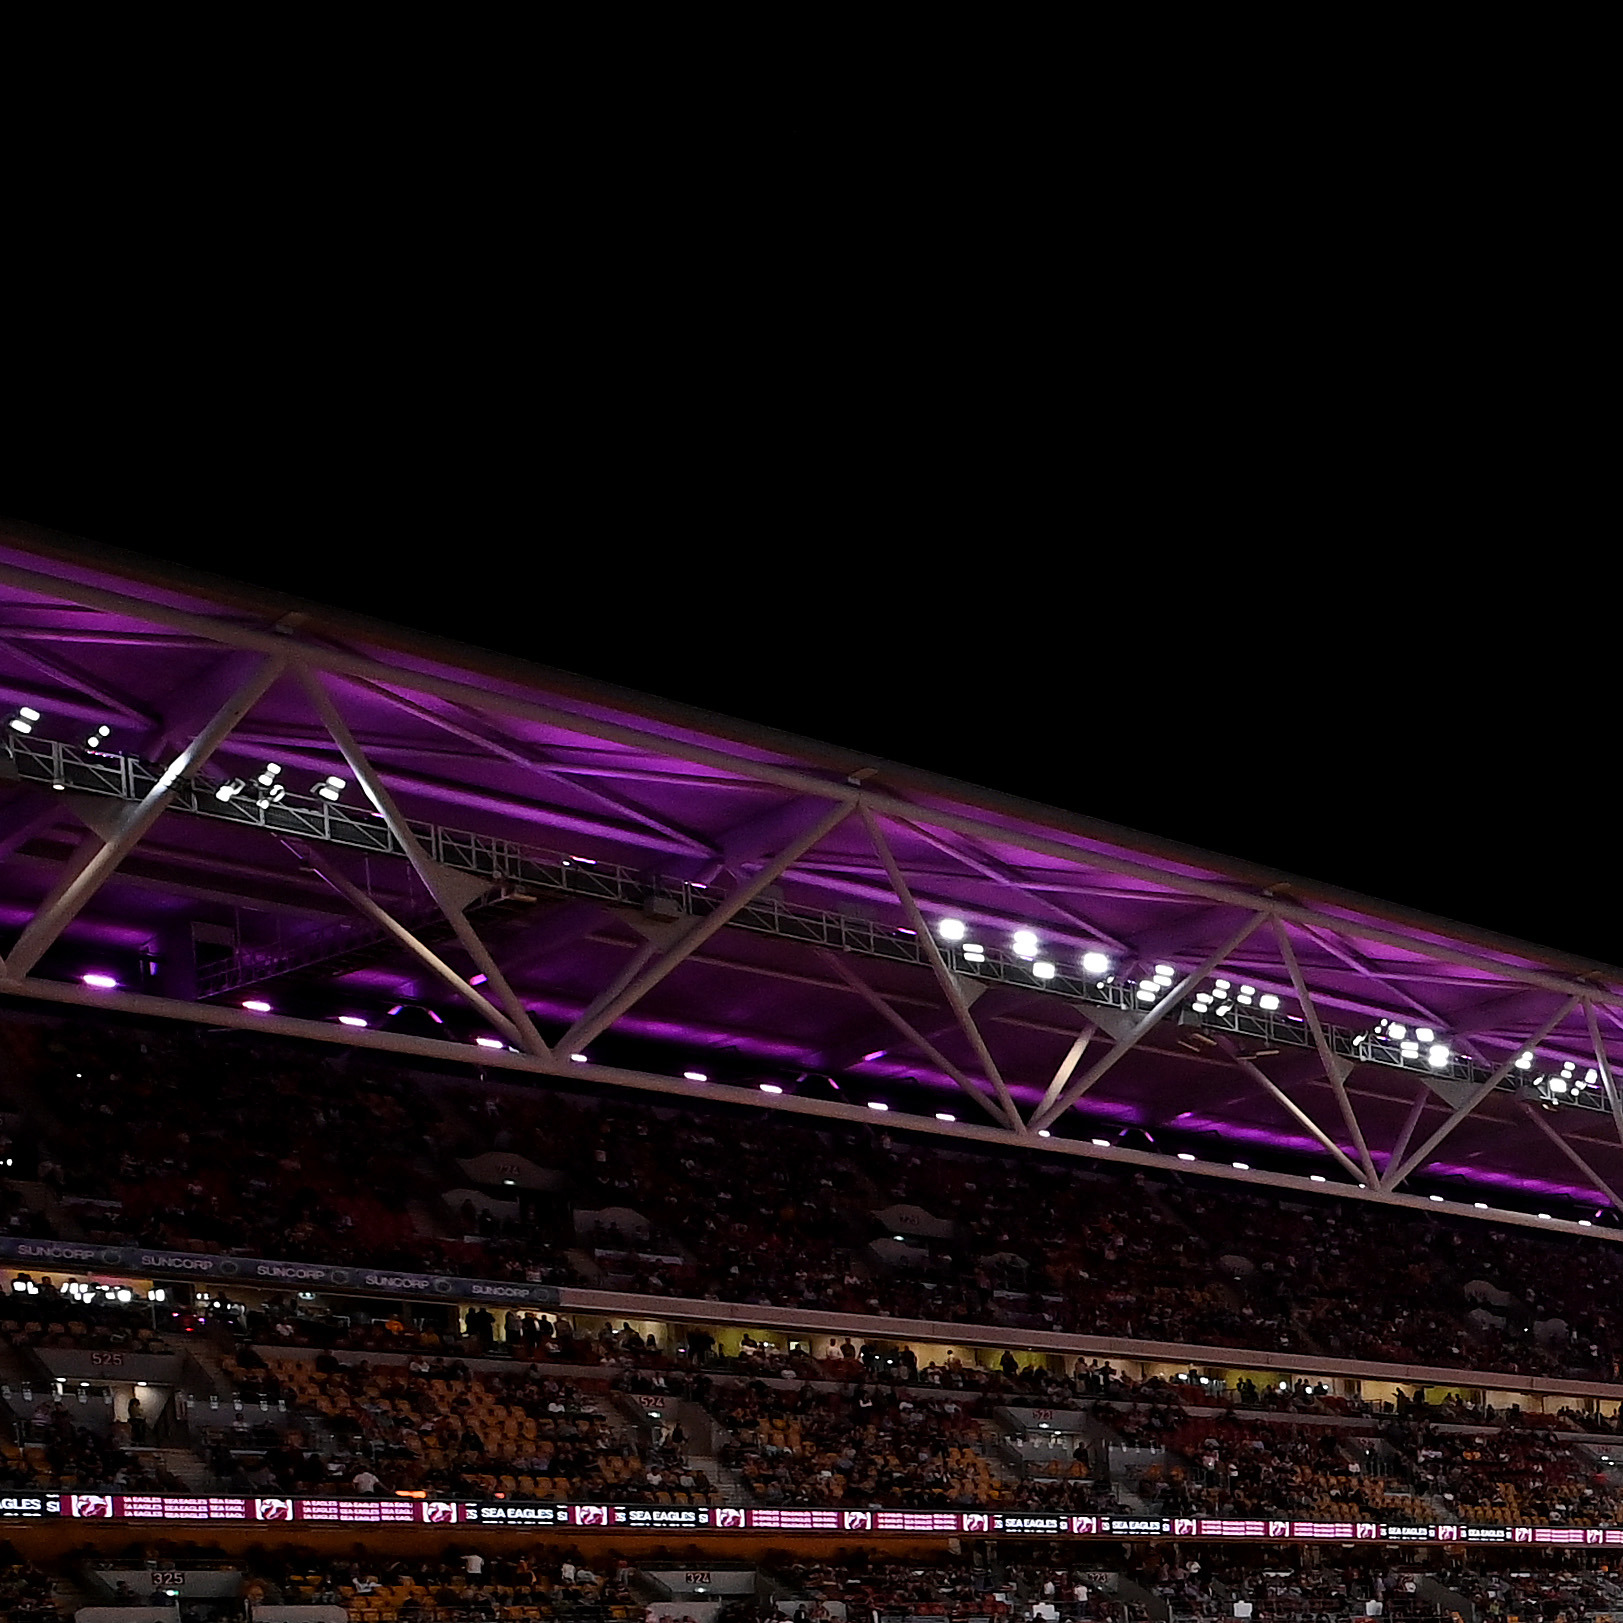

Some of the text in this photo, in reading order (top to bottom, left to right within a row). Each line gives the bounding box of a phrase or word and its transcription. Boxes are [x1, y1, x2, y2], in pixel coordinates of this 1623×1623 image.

[18, 1244, 95, 1261] SUNCORP
[142, 1255, 214, 1271] SUNCORP
[256, 1264, 325, 1280] SUNCORP
[365, 1274, 430, 1290] SUNCORP
[472, 1284, 530, 1298] SUNCORP
[91, 1352, 123, 1365] 525
[641, 1396, 664, 1408] 524
[0, 1499, 41, 1511] GLES
[481, 1508, 554, 1519] SEA EAGLES
[629, 1511, 695, 1522] SEA EAGLES
[153, 1572, 183, 1585] 325
[687, 1572, 710, 1584] 324
